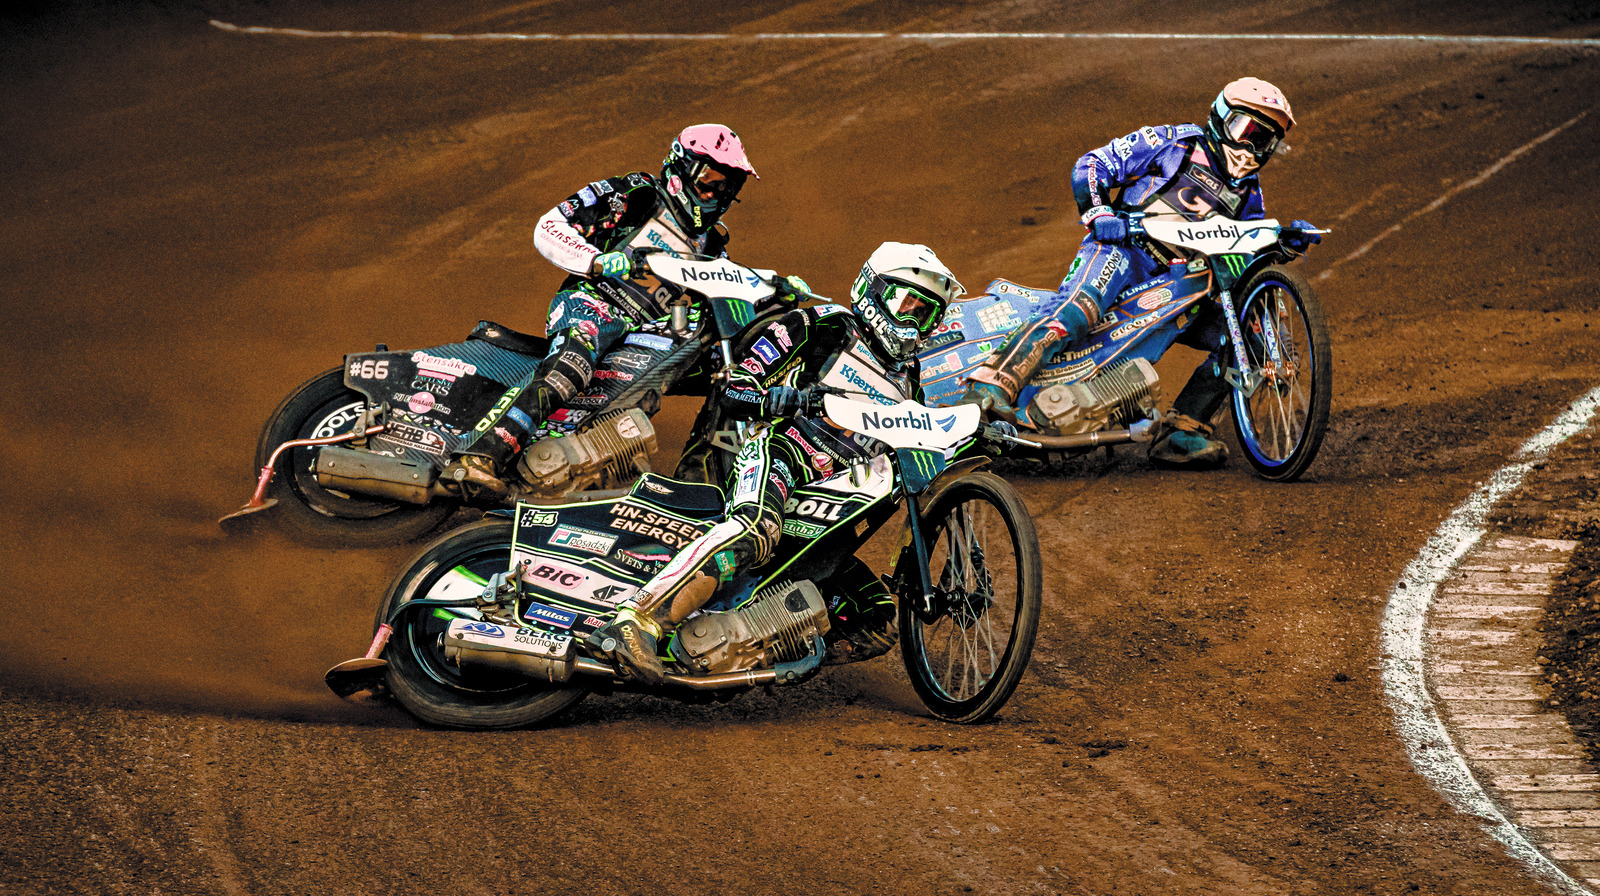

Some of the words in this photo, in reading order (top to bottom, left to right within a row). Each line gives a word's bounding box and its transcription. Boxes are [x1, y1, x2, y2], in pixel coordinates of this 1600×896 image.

[1205, 177, 1219, 191] GLS
[1177, 224, 1241, 242] Norrbil
[681, 267, 743, 284] Norrbil
[350, 360, 389, 380] #66
[413, 352, 476, 375] Stensåkra
[411, 380, 450, 396] CARS
[318, 404, 367, 438] OOLS
[861, 411, 932, 431] Norrbil
[820, 442, 841, 461] MARTIN
[853, 432, 885, 458] GLS
[521, 509, 558, 527] #54
[783, 498, 843, 521] BOLL
[610, 503, 705, 542] HN-SPEED
[609, 517, 691, 550] ENERGY
[568, 537, 613, 553] posadzki
[614, 548, 644, 571] SVETS
[532, 608, 570, 622] Mitas
[514, 635, 564, 650] SOLUTIONS
[516, 628, 568, 643] BERG
